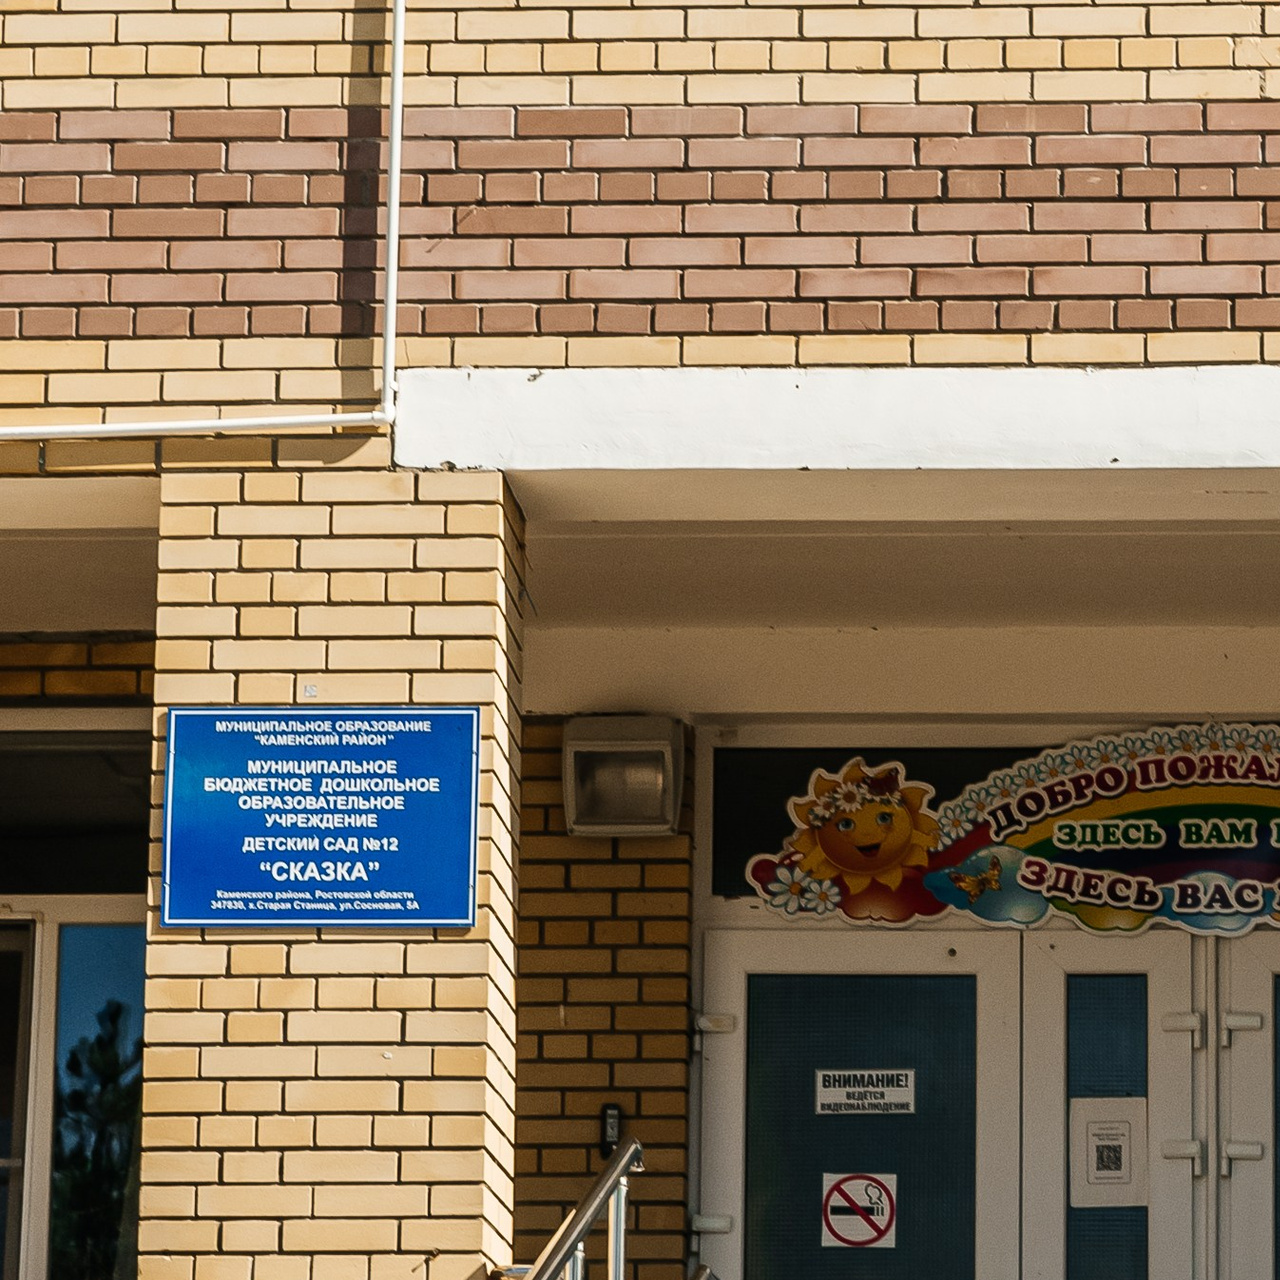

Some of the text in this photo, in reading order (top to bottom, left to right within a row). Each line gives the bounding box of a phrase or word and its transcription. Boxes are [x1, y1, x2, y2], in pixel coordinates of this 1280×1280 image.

[215, 720, 432, 734] МУНИЦИПАЛЬНОЕ ОБРАЗОВАНИЕ
[247, 760, 398, 776] МУНИЦИПАЛЬНОЕ
[203, 778, 441, 794] БЮДЖЕТНОЕ ДОШКОЛЬНОЕ
[238, 796, 405, 810] ОБРАЗОВАТЕЛЬНОЕ
[987, 765, 1125, 838] ДОБРО
[264, 813, 378, 830] УЧРЕЖДЕНИЕ
[1055, 821, 1164, 849] ЗДЕСЬ
[1182, 821, 1254, 846] ВАМ
[241, 835, 399, 853] ДЕТСКИЙ САД №12
[1020, 858, 1161, 907] ЗДЕСЬ
[1174, 880, 1261, 911] ВАС
[822, 1073, 909, 1088] ВНИМАНИЕ!
[821, 1102, 911, 1112] ВИДЕОНАБЛЮДЕНИЕ
